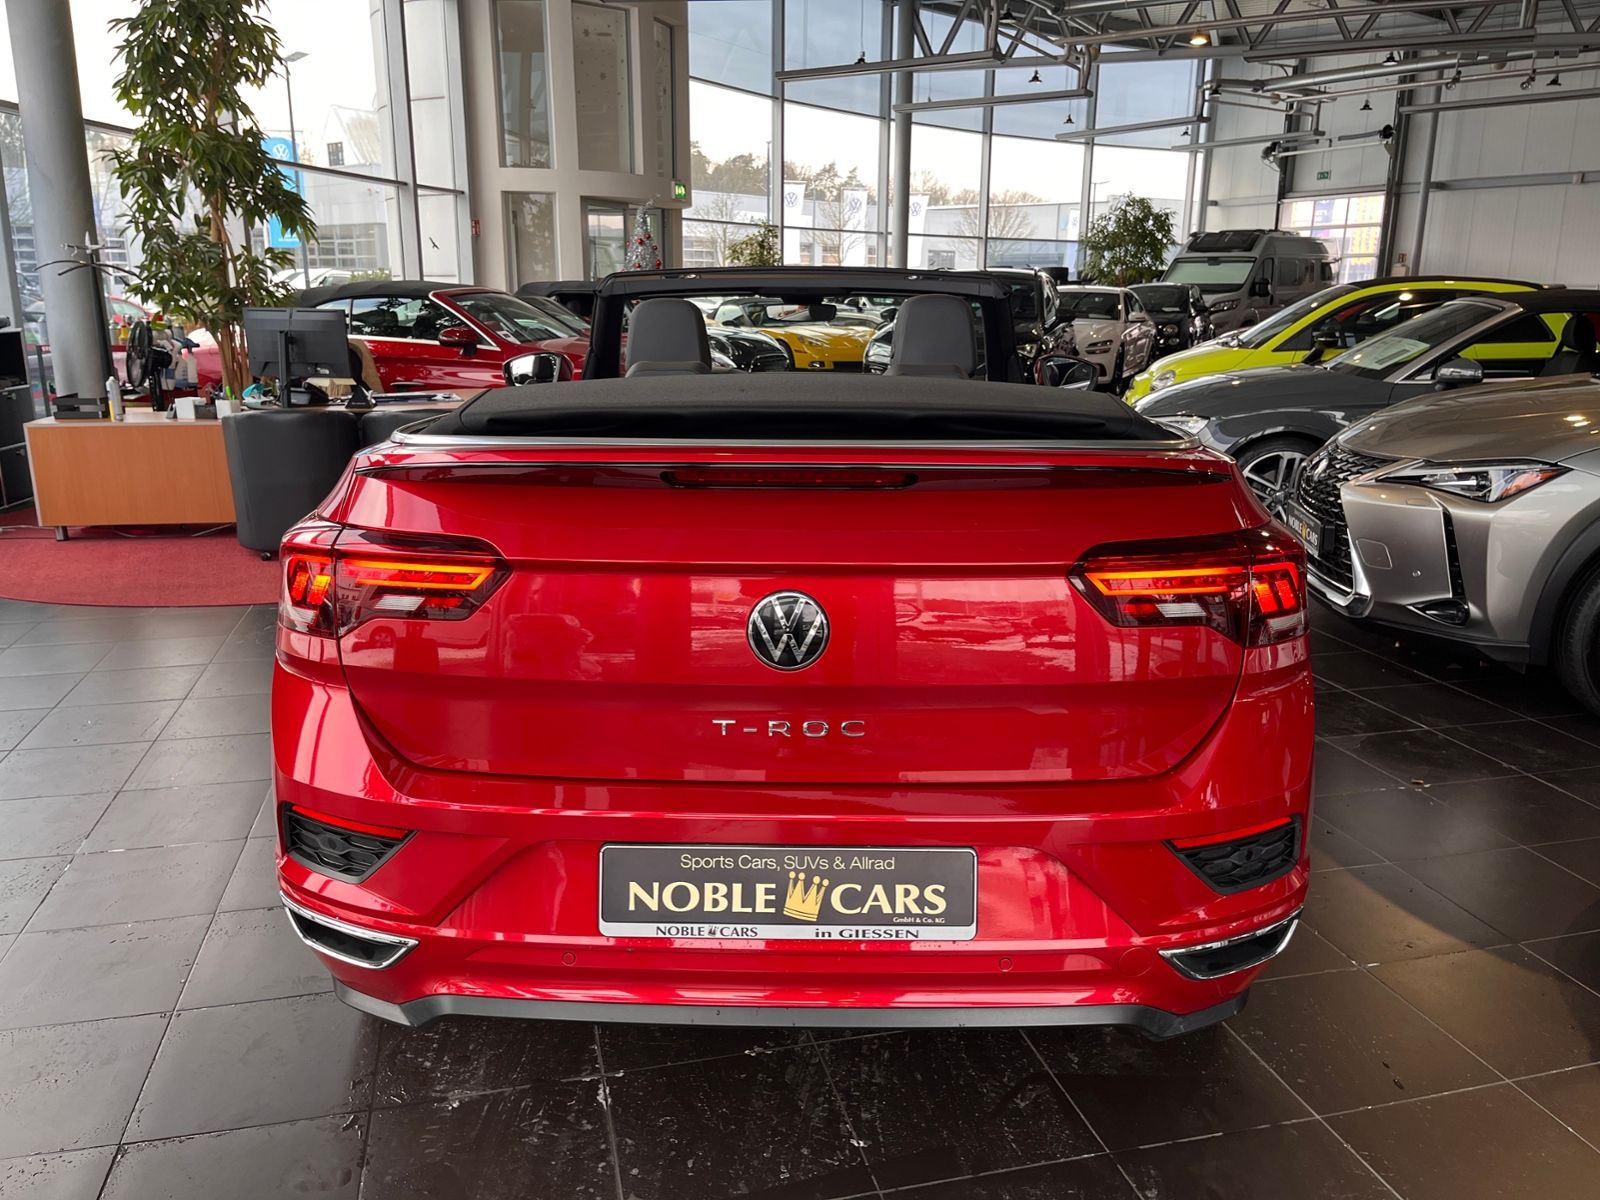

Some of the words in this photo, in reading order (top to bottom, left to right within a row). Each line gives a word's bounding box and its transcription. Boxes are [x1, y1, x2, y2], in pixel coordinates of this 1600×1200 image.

[749, 592, 828, 669] VW
[711, 719, 866, 737] T-ROC
[680, 853, 734, 872] Sports
[738, 855, 780, 871] Cars,
[784, 856, 829, 870] SUVs
[834, 856, 846, 870] &
[849, 856, 896, 870] Allrad
[628, 881, 777, 914] NOBLE
[830, 883, 948, 915] CARS
[655, 925, 705, 937] NOBLE
[719, 926, 758, 937] CARS
[815, 927, 832, 938] in
[838, 928, 920, 939] GIESSEN
